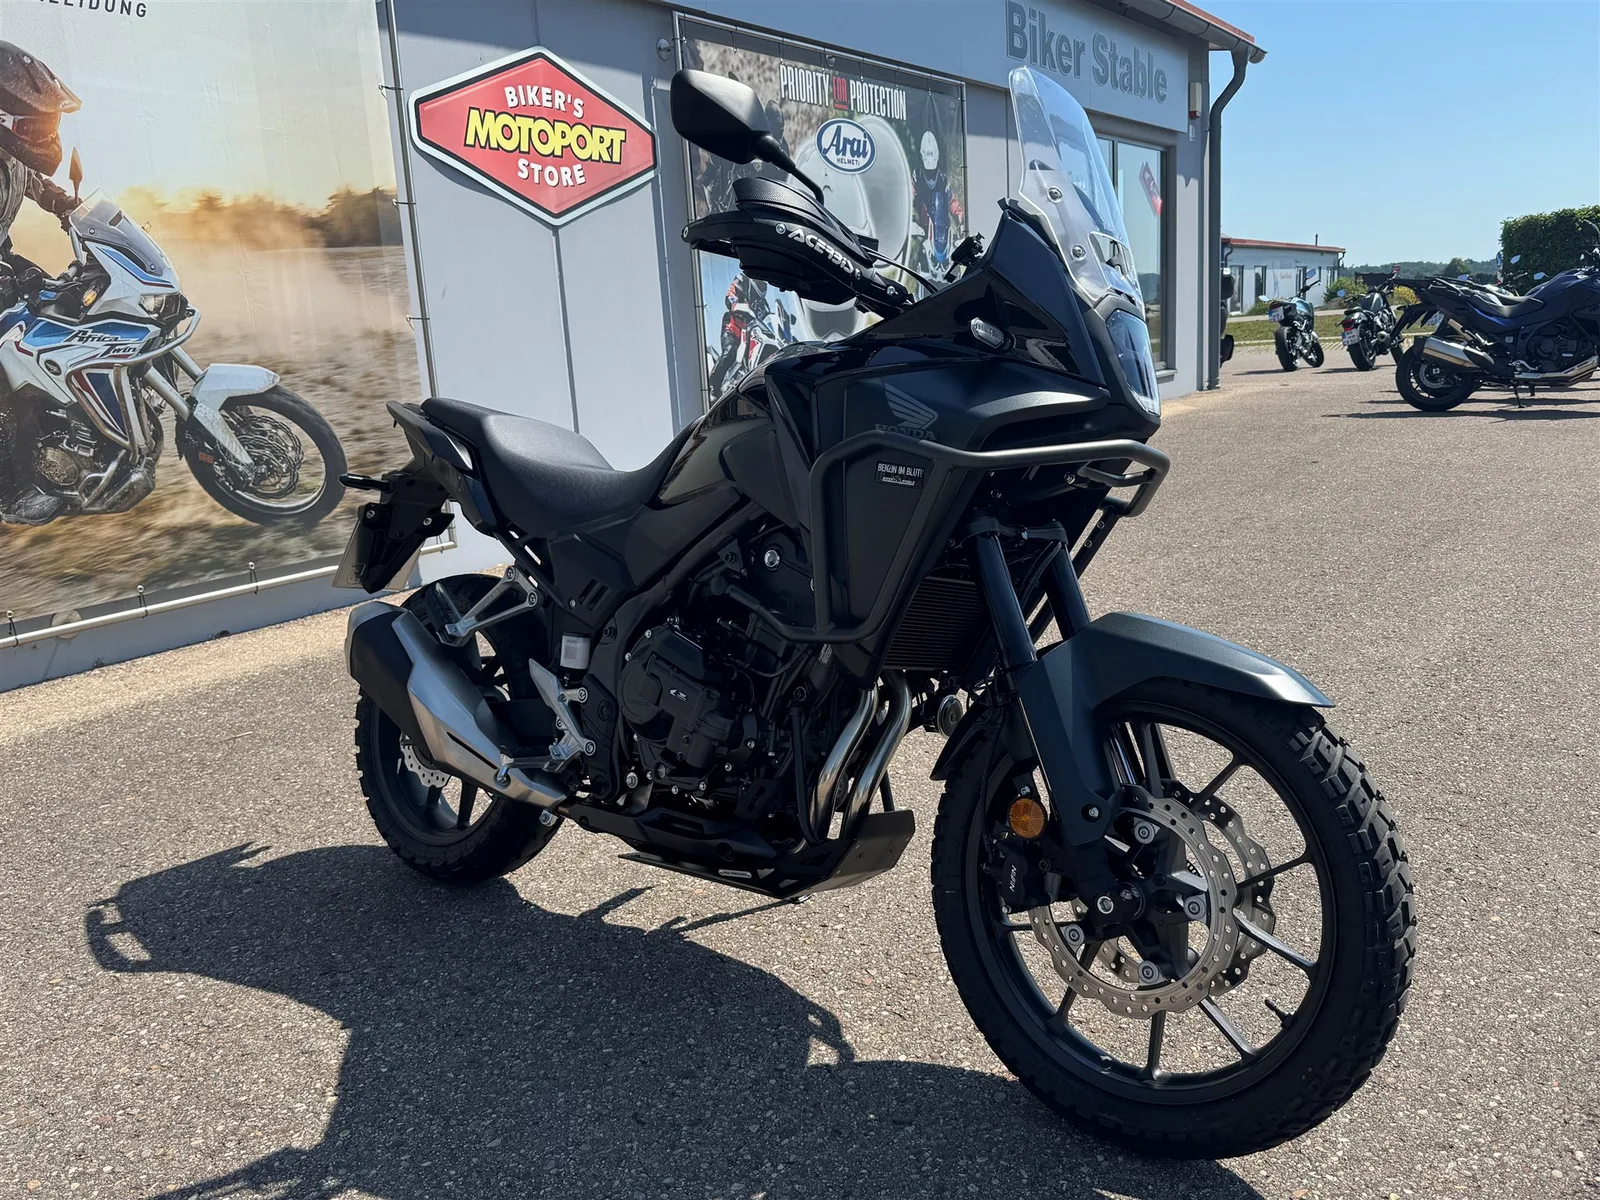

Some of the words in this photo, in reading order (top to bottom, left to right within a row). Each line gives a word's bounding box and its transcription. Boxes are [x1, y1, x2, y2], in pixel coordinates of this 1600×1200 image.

[1006, 0, 1086, 79] Biker
[1092, 32, 1168, 104] Stable
[504, 85, 585, 119] BIKER'S
[779, 64, 829, 107] PRIORITY
[832, 75, 848, 103] FOR
[850, 79, 906, 120] PROTECTION
[464, 107, 627, 165] MOTOPORT
[821, 125, 869, 159] Arai
[517, 158, 587, 188] STORE
[63, 329, 121, 344] Africa
[99, 343, 140, 358] Twin
[874, 423, 937, 441] HONDA
